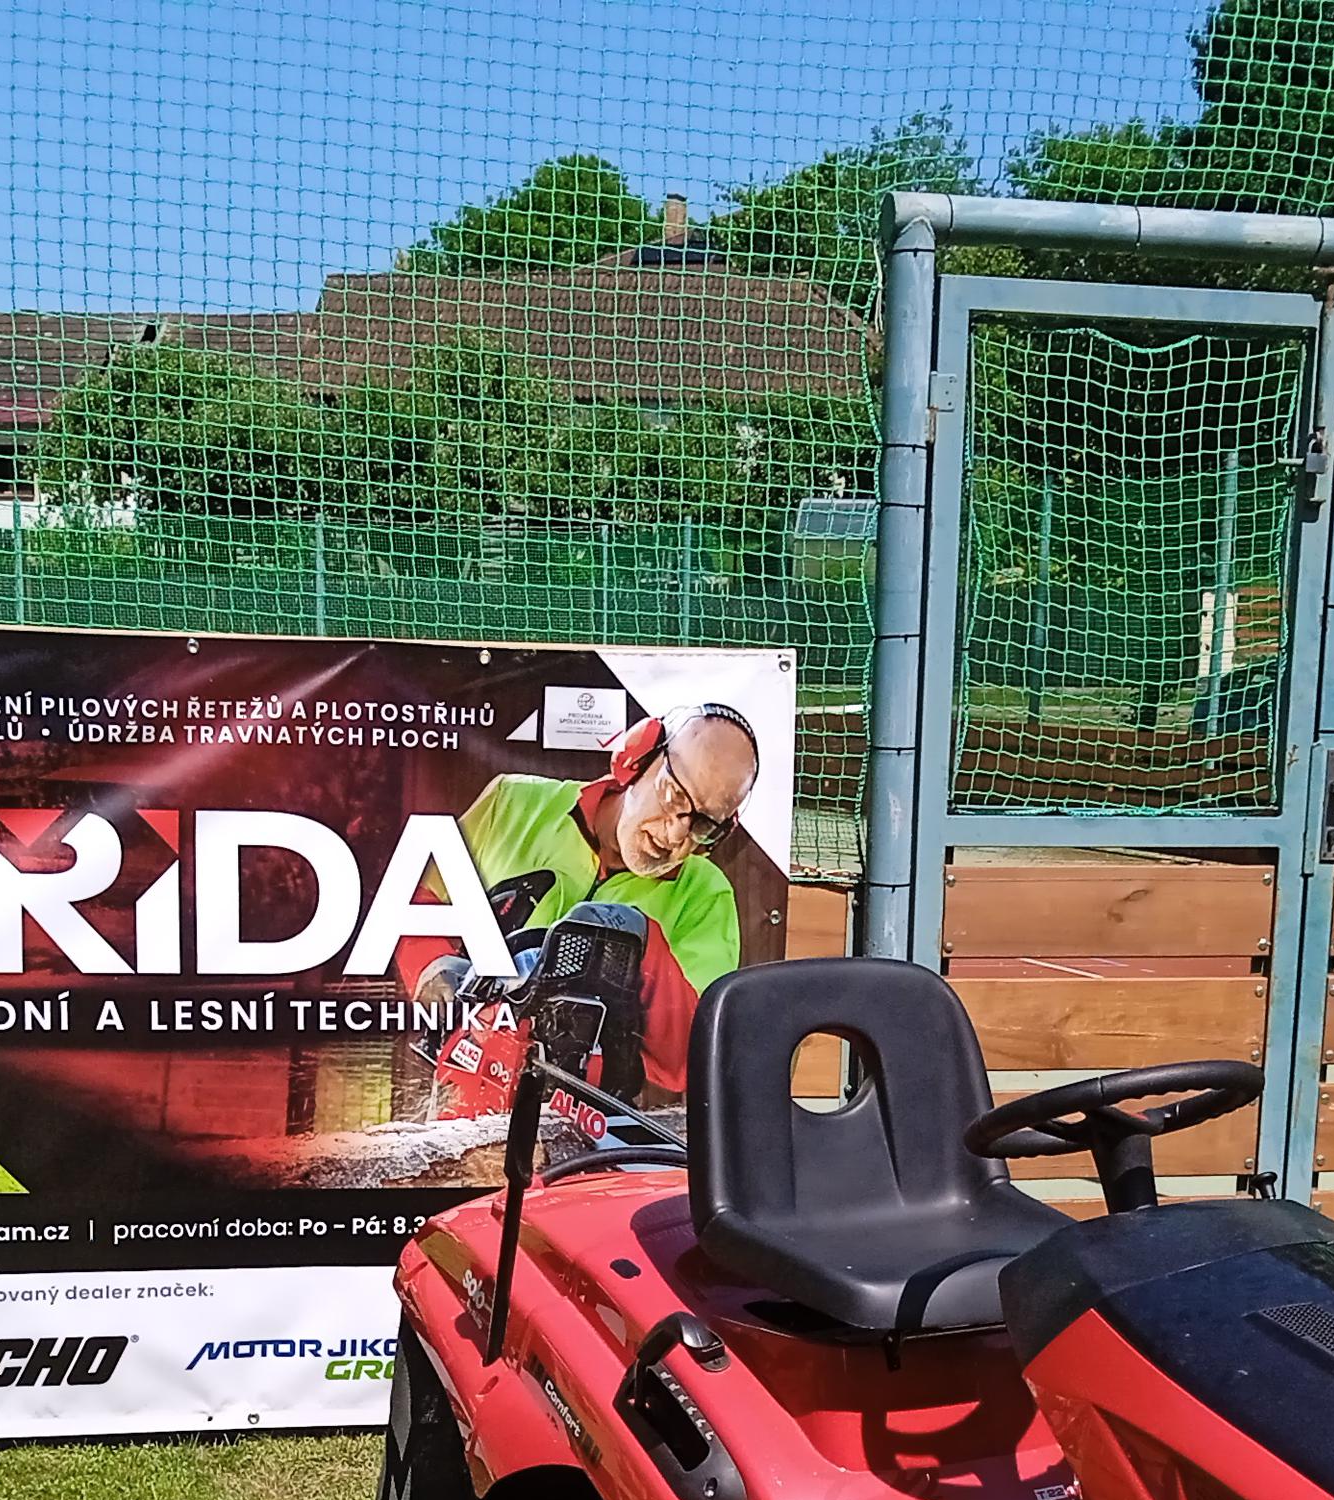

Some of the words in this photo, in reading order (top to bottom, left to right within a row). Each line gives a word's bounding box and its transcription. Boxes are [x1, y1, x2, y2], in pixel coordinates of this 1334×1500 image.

[41, 690, 178, 718] PILOVÝCH
[291, 700, 308, 720] A
[315, 702, 495, 728] PLOTOSTŘIHŮ
[68, 715, 174, 744] ÚDRŽBA
[182, 720, 362, 747] TRAVNATÝCH
[371, 727, 459, 751] PLOCH
[95, 1000, 125, 1032] A
[150, 990, 275, 1032] LESNÍ
[289, 1000, 519, 1033] TECHNIKA
[113, 1218, 220, 1245] pracovní
[225, 1216, 294, 1239] doba:
[299, 1217, 328, 1237] Po
[352, 1215, 387, 1235] Pá:
[65, 1283, 132, 1302] dealer
[136, 1281, 215, 1300] značek:
[184, 1338, 323, 1371] MOTOR
[544, 1379, 582, 1437] Comfort
